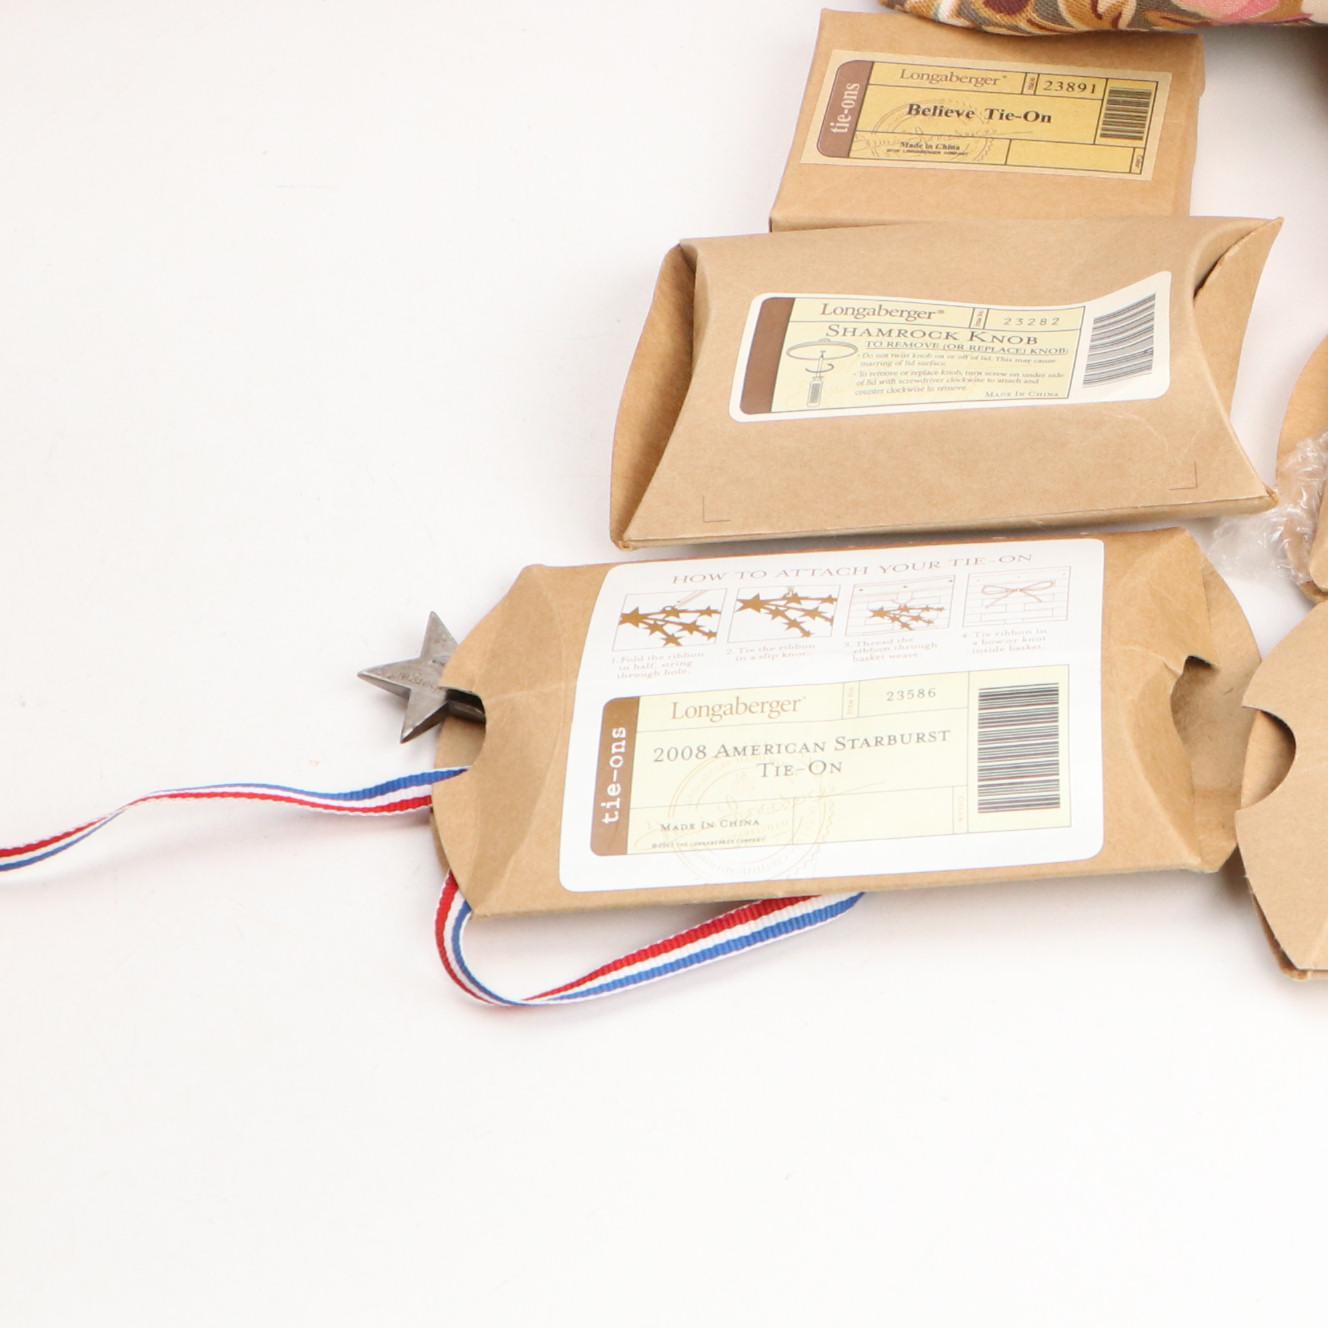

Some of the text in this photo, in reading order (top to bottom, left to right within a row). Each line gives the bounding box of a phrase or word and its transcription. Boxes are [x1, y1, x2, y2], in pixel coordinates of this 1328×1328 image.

[1043, 79, 1098, 95] 23891
[829, 82, 860, 135] tie-ons
[907, 103, 1053, 124] Believe Tie-On
[1003, 317, 1060, 327] 23282
[826, 323, 1039, 346] SHAMROCK KNOB
[673, 553, 1034, 585] HOW TO ATTACH YOUR TIE-ON
[886, 687, 937, 702] 23586
[653, 729, 951, 763] 2008 AMERICAN STARBURST
[601, 726, 626, 824] tie-ons
[757, 759, 843, 778] TIE-ON
[660, 819, 760, 831] MADE IN CHINA
